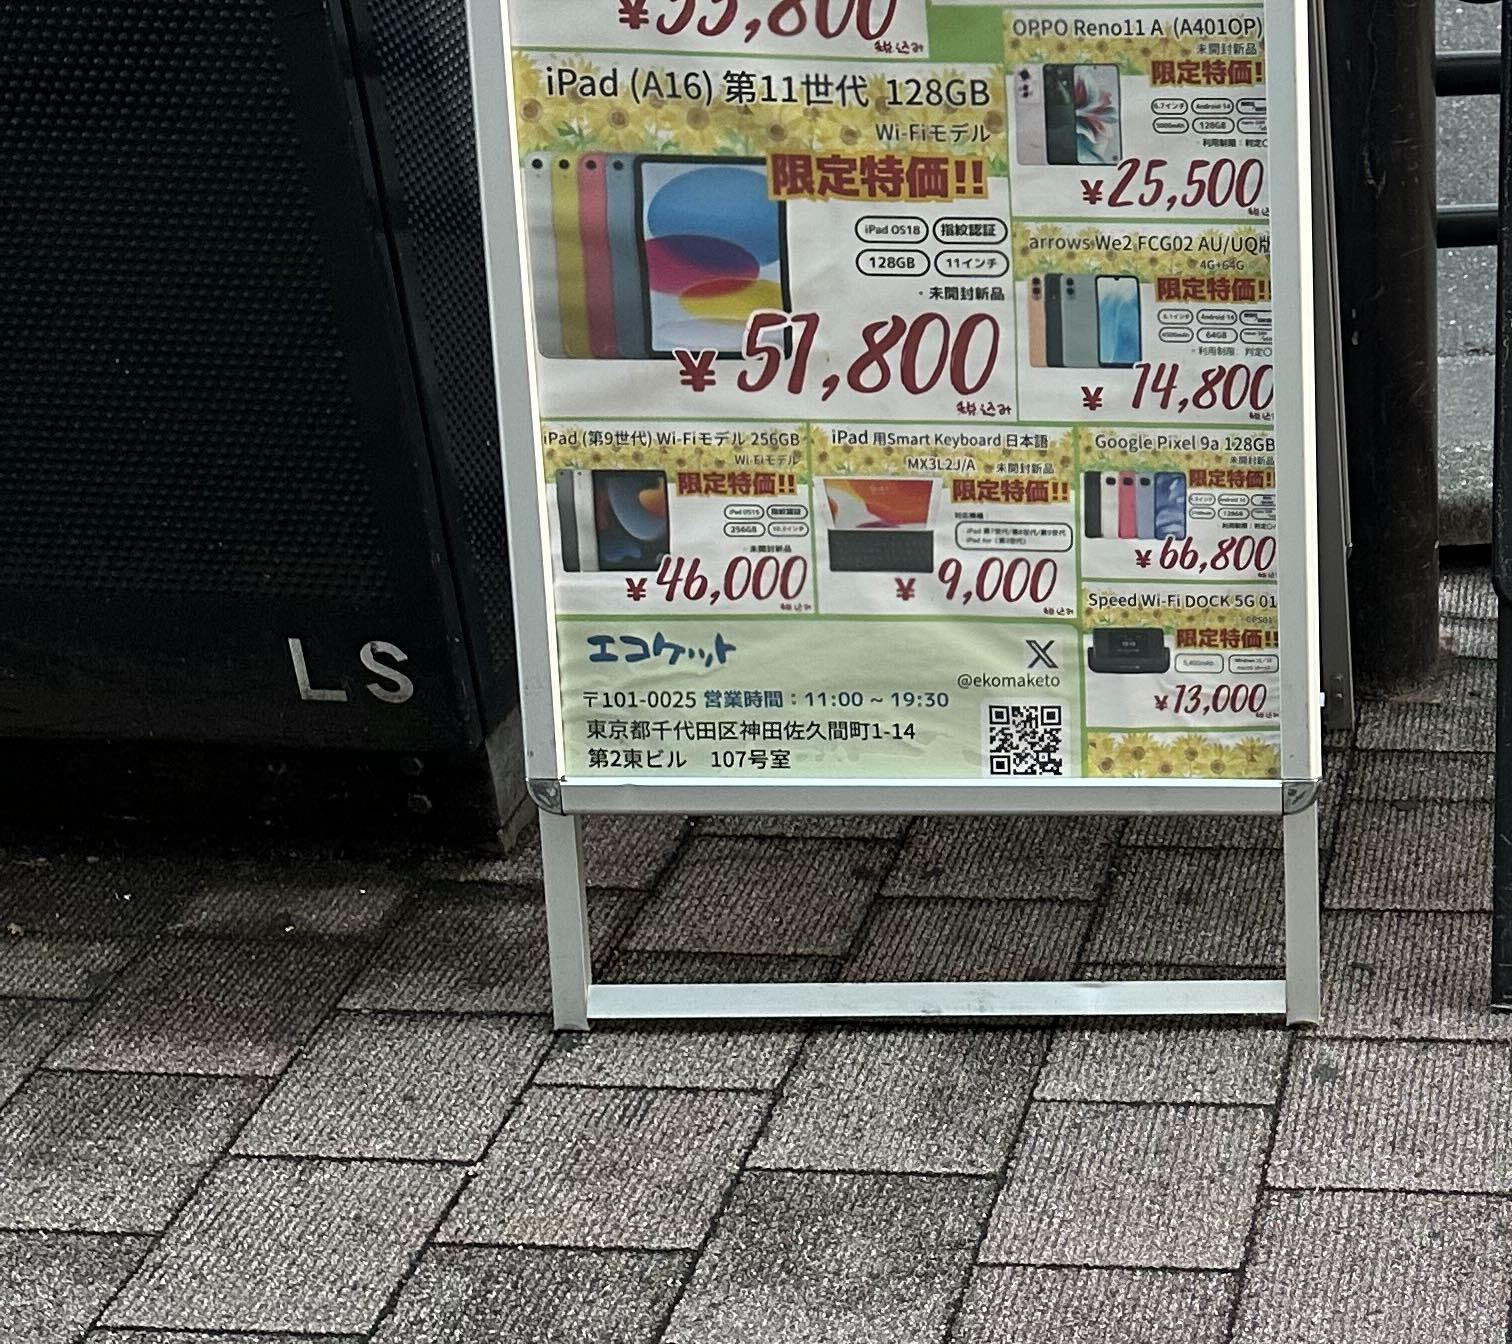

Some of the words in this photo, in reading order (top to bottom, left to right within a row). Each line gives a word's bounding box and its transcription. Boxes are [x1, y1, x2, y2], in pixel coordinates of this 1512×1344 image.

[1012, 19, 1068, 37] OPPO
[1073, 18, 1144, 36] Reno11
[1150, 19, 1164, 36] A
[546, 67, 620, 99] iPad
[630, 69, 714, 106] (A16)
[722, 70, 870, 107] 第11世代
[886, 78, 990, 107] 128GB
[875, 122, 991, 144] Wi-Fiモデル
[770, 156, 985, 198] 限定特価!!
[1081, 157, 1265, 212] ¥25,500
[1028, 236, 1096, 251] arrows
[1095, 235, 1133, 252] We2
[1138, 235, 1193, 253] FCG02
[869, 257, 916, 270] 128GB
[946, 258, 998, 270] 11インチ
[543, 431, 577, 446] iPad
[582, 430, 652, 448] (第9世代)
[656, 431, 745, 446] Wi-Fiモデル
[751, 432, 800, 447] 256GB
[831, 429, 868, 446] iPad
[933, 432, 1001, 449] Keyboard
[1006, 434, 1049, 449] 日本語
[1095, 434, 1153, 453] Google
[1156, 435, 1197, 451] Pixel
[1200, 436, 1220, 451] 9a
[1225, 436, 1276, 453] 128GB
[677, 471, 796, 496] 限定特価!!
[953, 478, 1069, 503] 限定特価!!
[1135, 535, 1277, 574] ¥66,800
[625, 555, 808, 606] ¥46,000
[895, 556, 1058, 606] ¥9,000
[1088, 592, 1137, 610] Speed
[1140, 593, 1181, 608] Wi-Fi
[1184, 594, 1231, 608] DOCK
[1234, 594, 1255, 608] 5G
[956, 673, 1061, 689] @ekomaketo
[582, 690, 697, 710] 〒101-0025
[804, 690, 864, 708] 11:00
[890, 691, 950, 708] 19:30
[1154, 683, 1268, 716] ¥13,000
[585, 719, 916, 742] 東京都千代田区神田佐久間町1-14
[587, 748, 687, 770] 第2東ビル
[710, 750, 792, 770] 107号室
